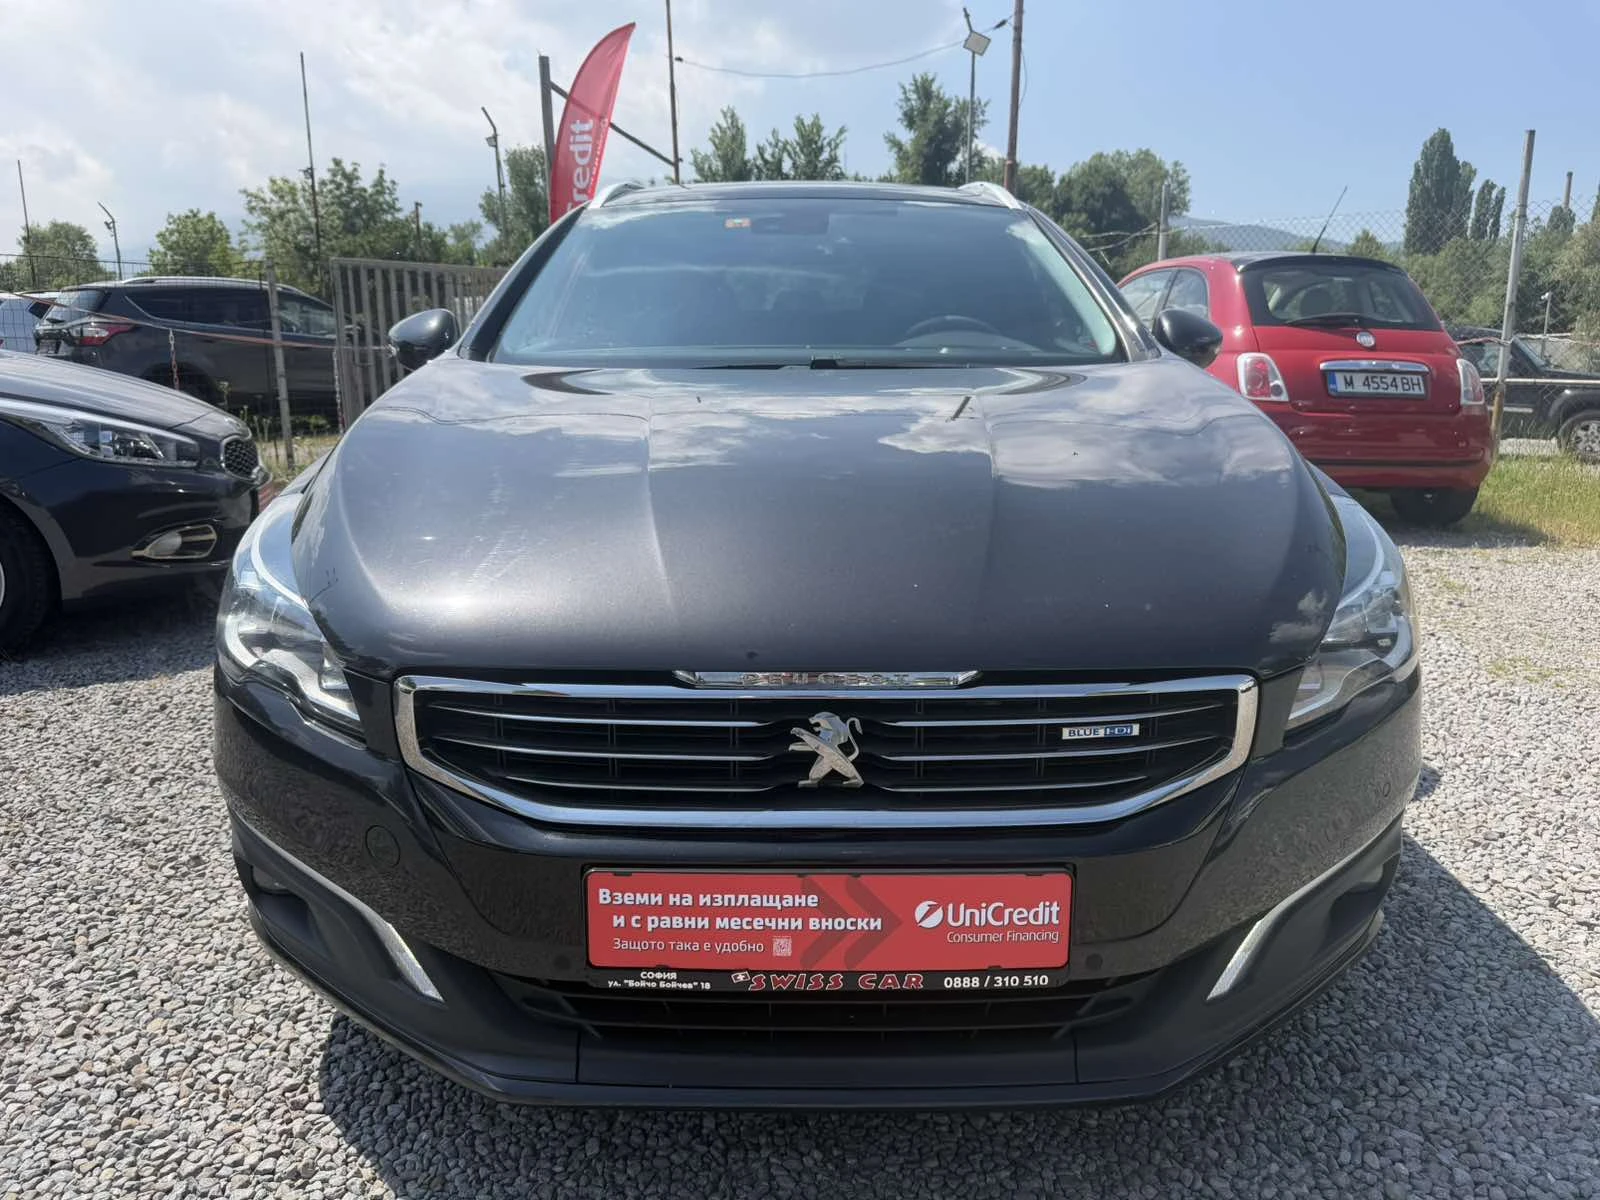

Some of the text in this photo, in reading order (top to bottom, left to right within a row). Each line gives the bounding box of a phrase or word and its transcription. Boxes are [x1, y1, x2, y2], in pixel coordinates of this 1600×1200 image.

[567, 119, 594, 211] redit
[1343, 375, 1422, 392] M 4554 BH
[1068, 727, 1099, 737] BLUE
[598, 888, 819, 910] Вземи на изплащане
[947, 900, 1060, 927] UniCredit
[612, 915, 882, 932] и с равни месечни вноски
[946, 930, 1059, 943] Consumer Financing
[613, 938, 764, 953] Защото така е удобно
[640, 971, 677, 980] СОФИЯ
[749, 973, 924, 991] SWISS CAR
[943, 976, 980, 989] 0888
[993, 976, 1020, 987] 310
[1023, 975, 1049, 986] 510
[700, 982, 711, 990] 18
